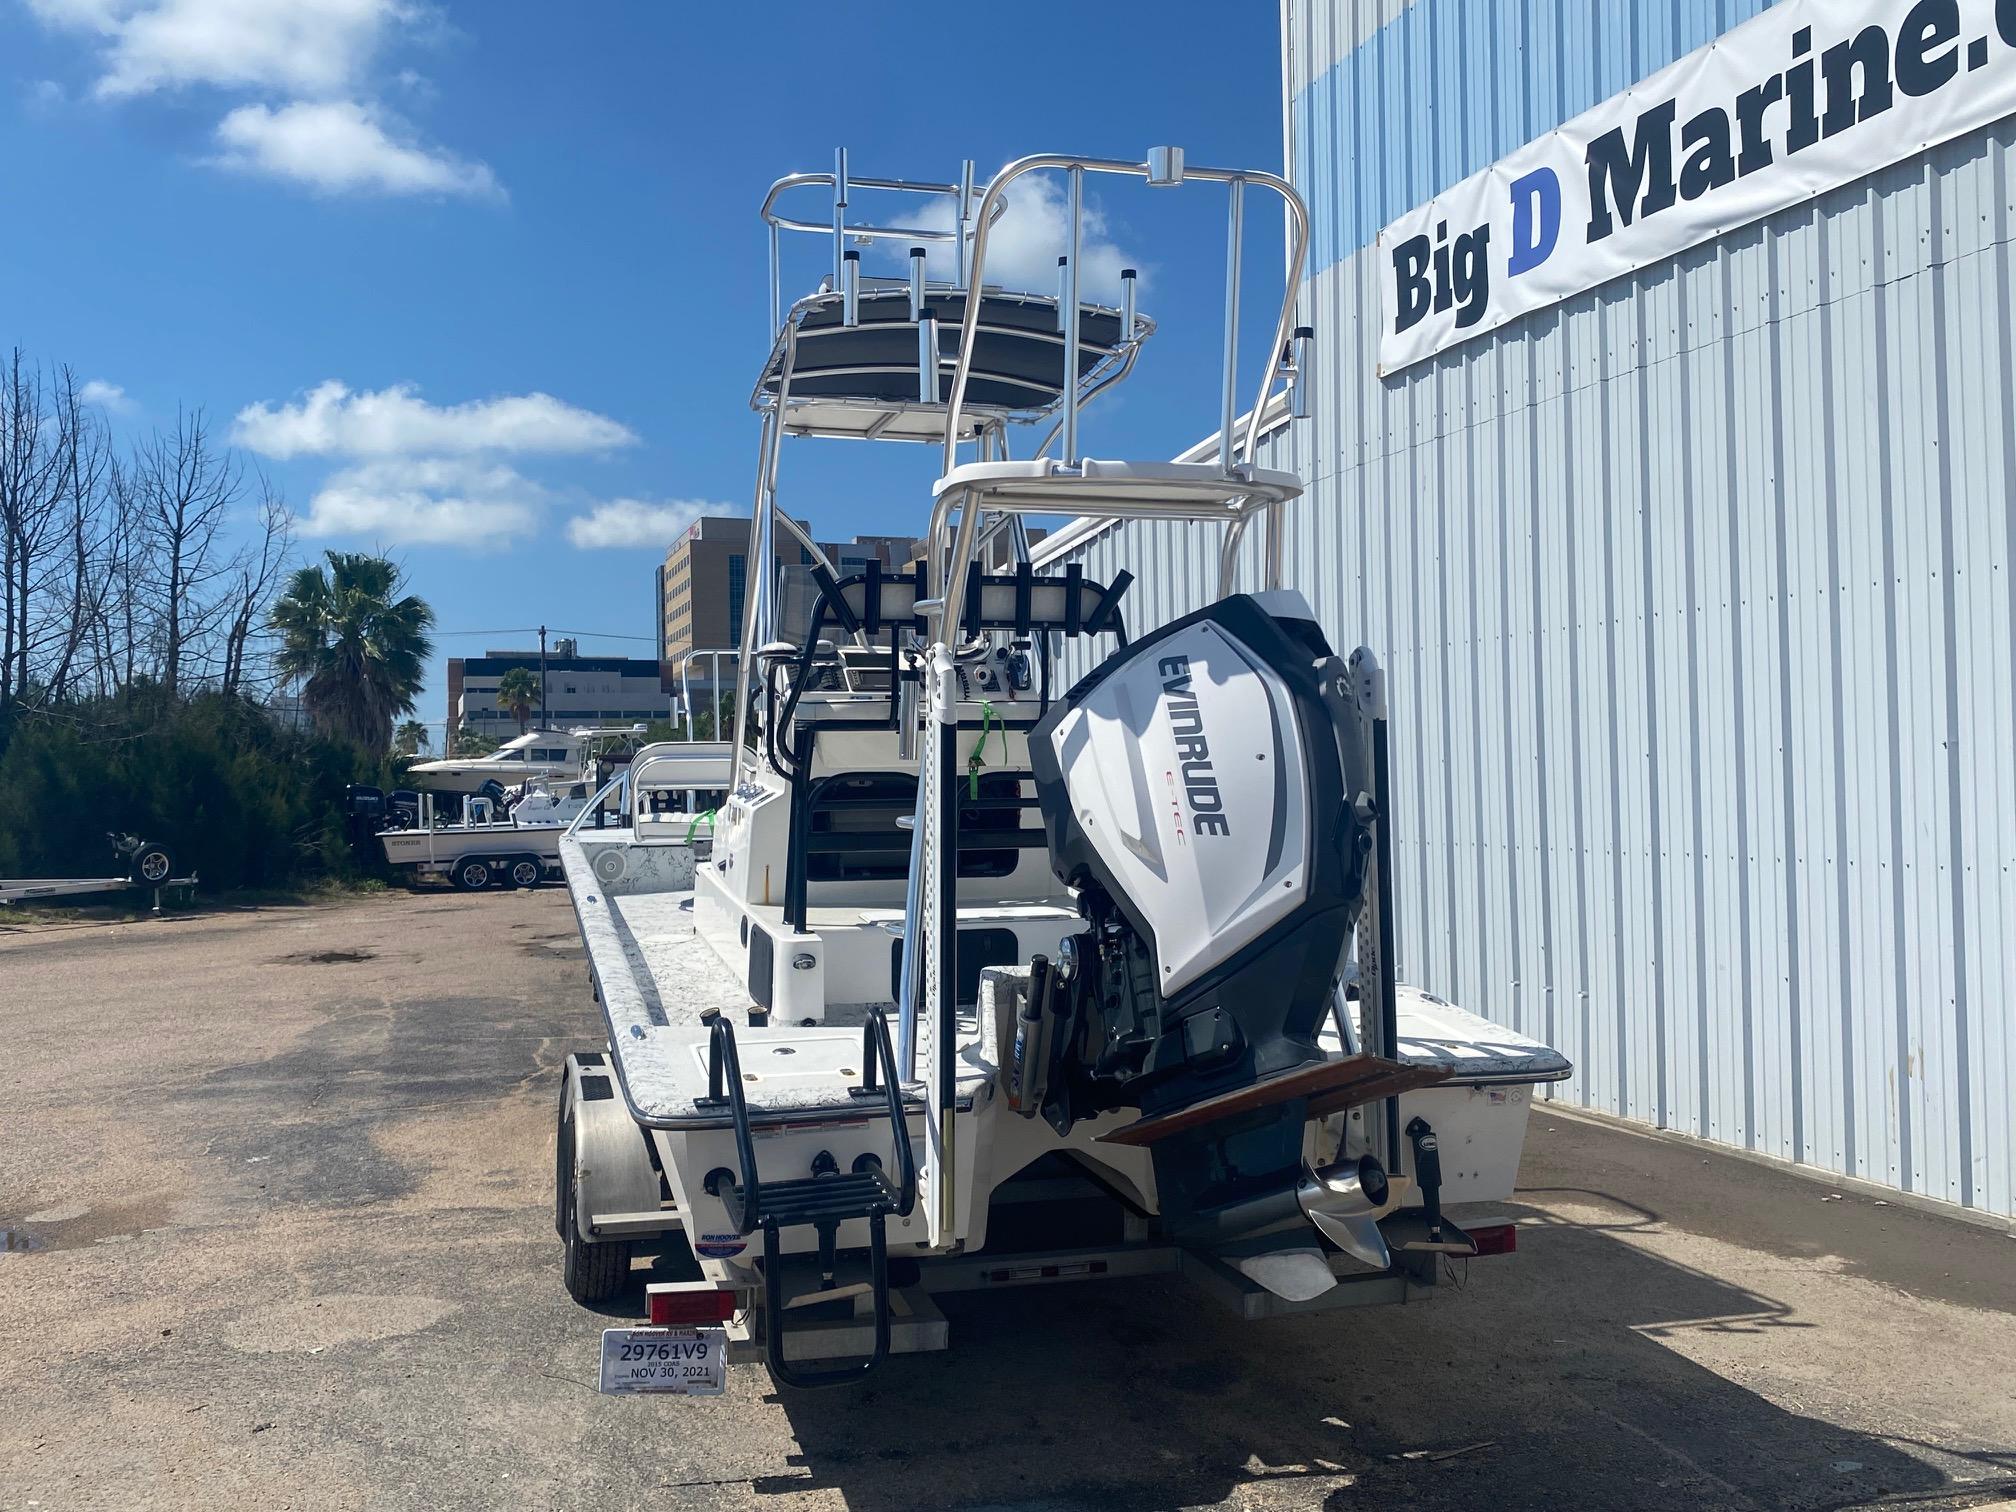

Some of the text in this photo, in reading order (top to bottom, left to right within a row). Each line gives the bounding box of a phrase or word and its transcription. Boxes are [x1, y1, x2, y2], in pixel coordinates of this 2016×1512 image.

[1392, 219, 1490, 335] Big
[1508, 167, 1562, 279] D
[1158, 655, 1230, 836] EVINRUDE
[620, 1343, 708, 1361] 29761V9
[631, 1367, 656, 1379] NOV
[660, 1367, 679, 1379] 30,
[682, 1366, 710, 1377] 2021
